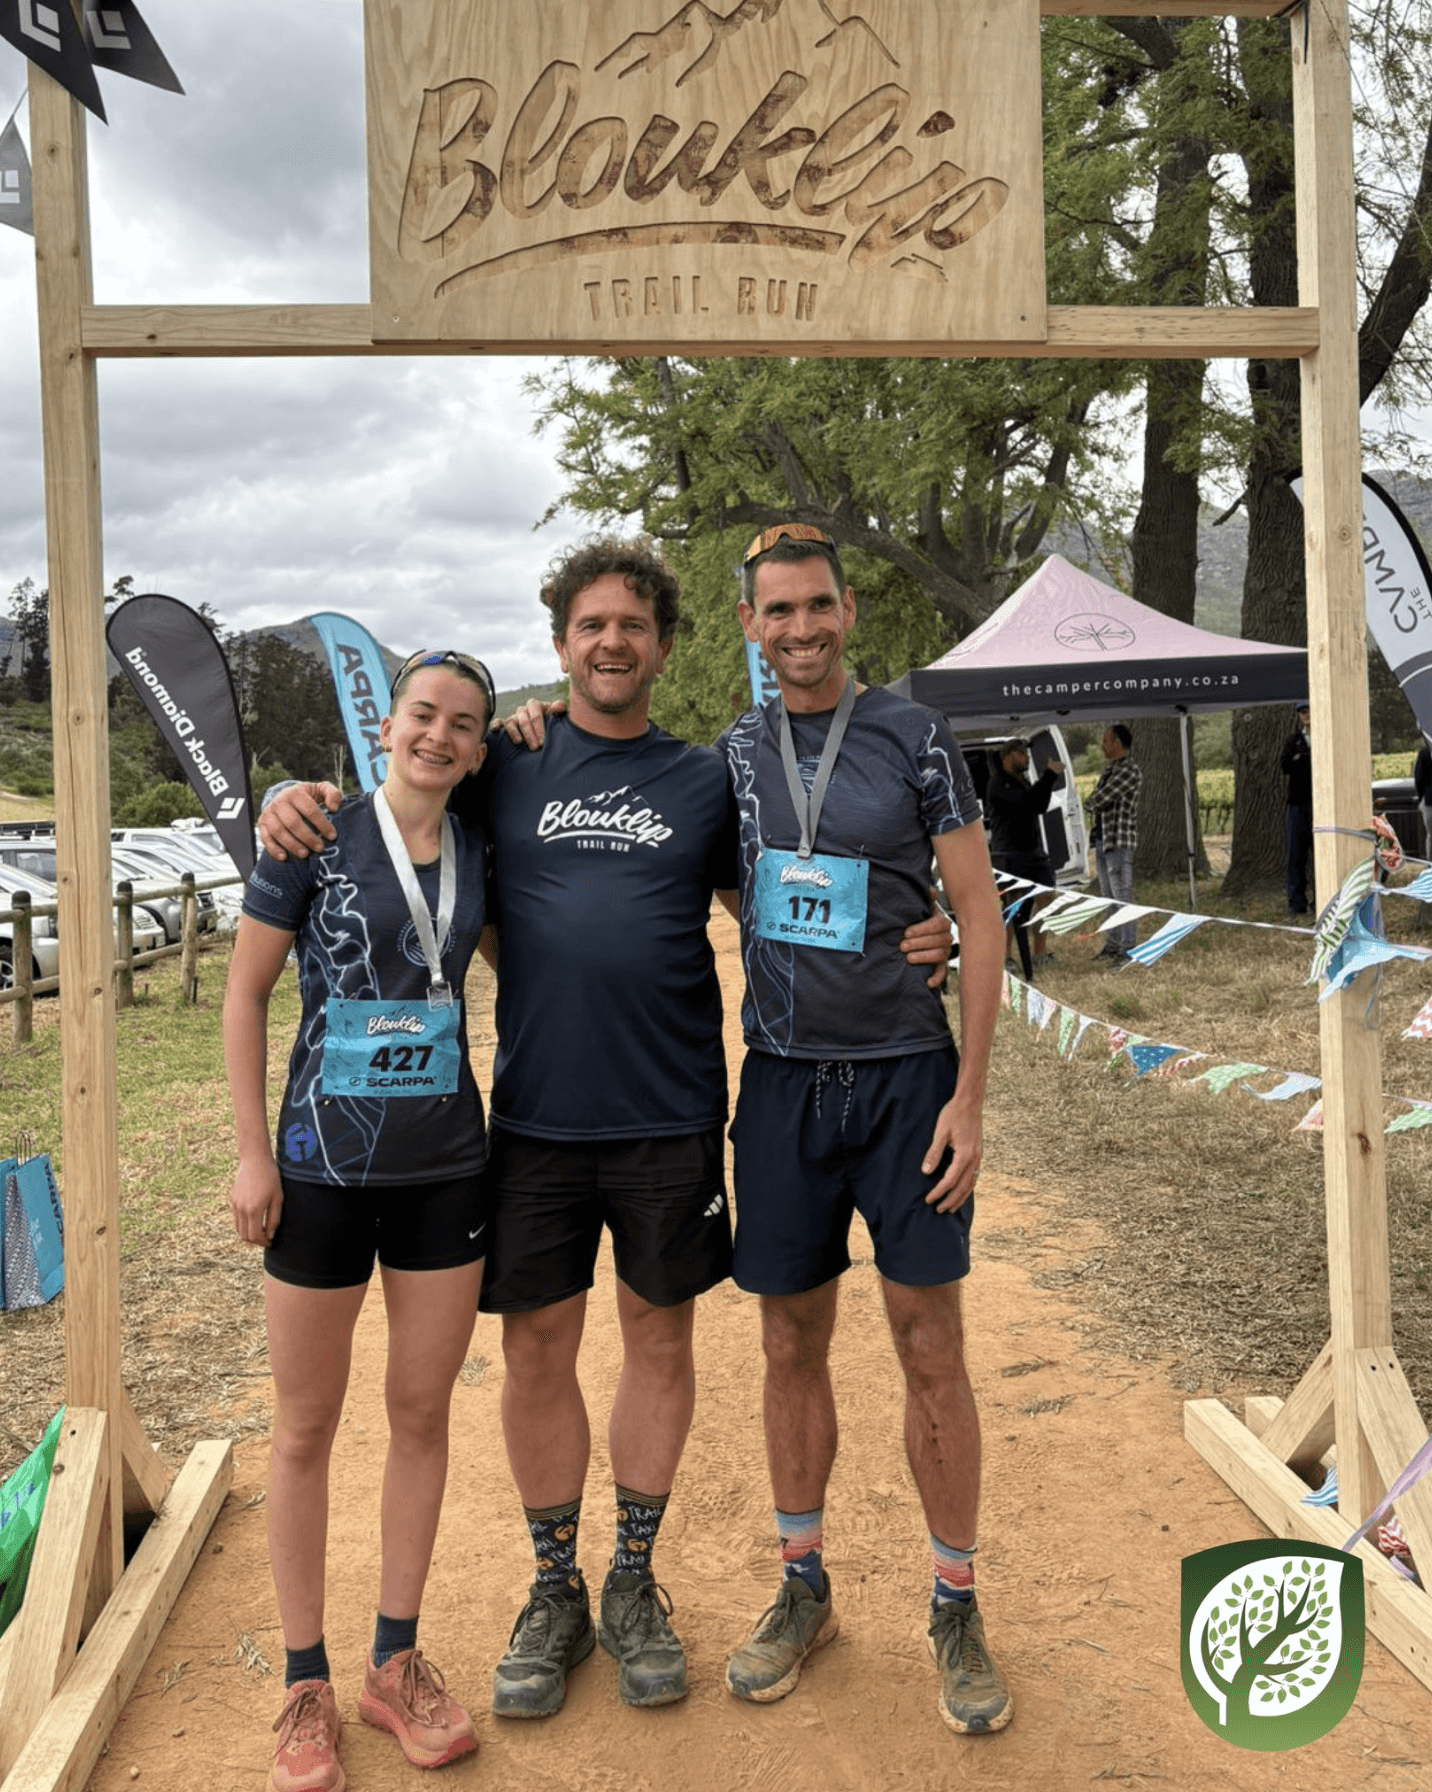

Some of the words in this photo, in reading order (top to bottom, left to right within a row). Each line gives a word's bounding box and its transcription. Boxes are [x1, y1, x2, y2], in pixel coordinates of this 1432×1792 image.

[398, 60, 1009, 271] Blouklip
[584, 275, 709, 321] TRAIL
[738, 276, 818, 321] RUN
[1003, 674, 1240, 697] thecampercompany.co.za
[537, 799, 673, 844] Blouklip
[577, 840, 605, 849] TRAIL
[610, 841, 630, 852] RUN
[789, 896, 831, 924] 171
[780, 923, 837, 939] SCARPA
[369, 1045, 433, 1072] 427
[366, 1077, 435, 1088] SCARPA
